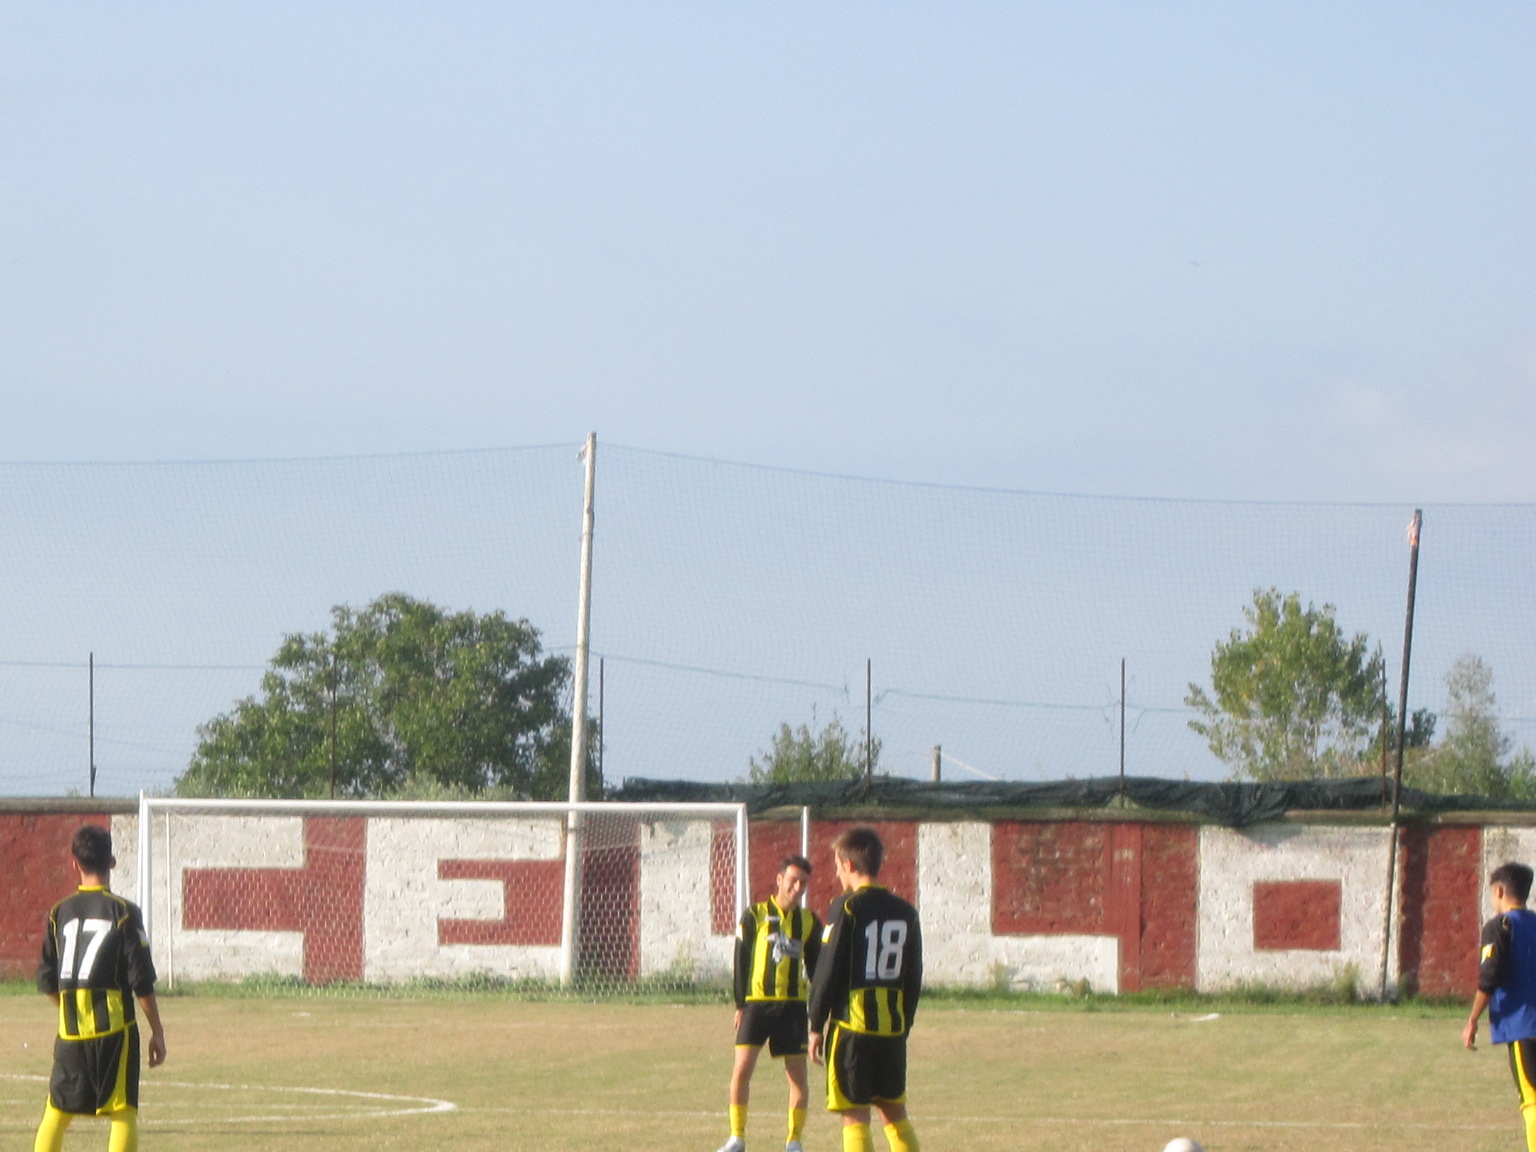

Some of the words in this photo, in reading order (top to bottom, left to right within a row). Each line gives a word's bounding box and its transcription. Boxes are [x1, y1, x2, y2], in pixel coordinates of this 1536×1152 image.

[110, 814, 1536, 995] CELLO
[60, 918, 113, 980] 17
[865, 919, 907, 980] 18
